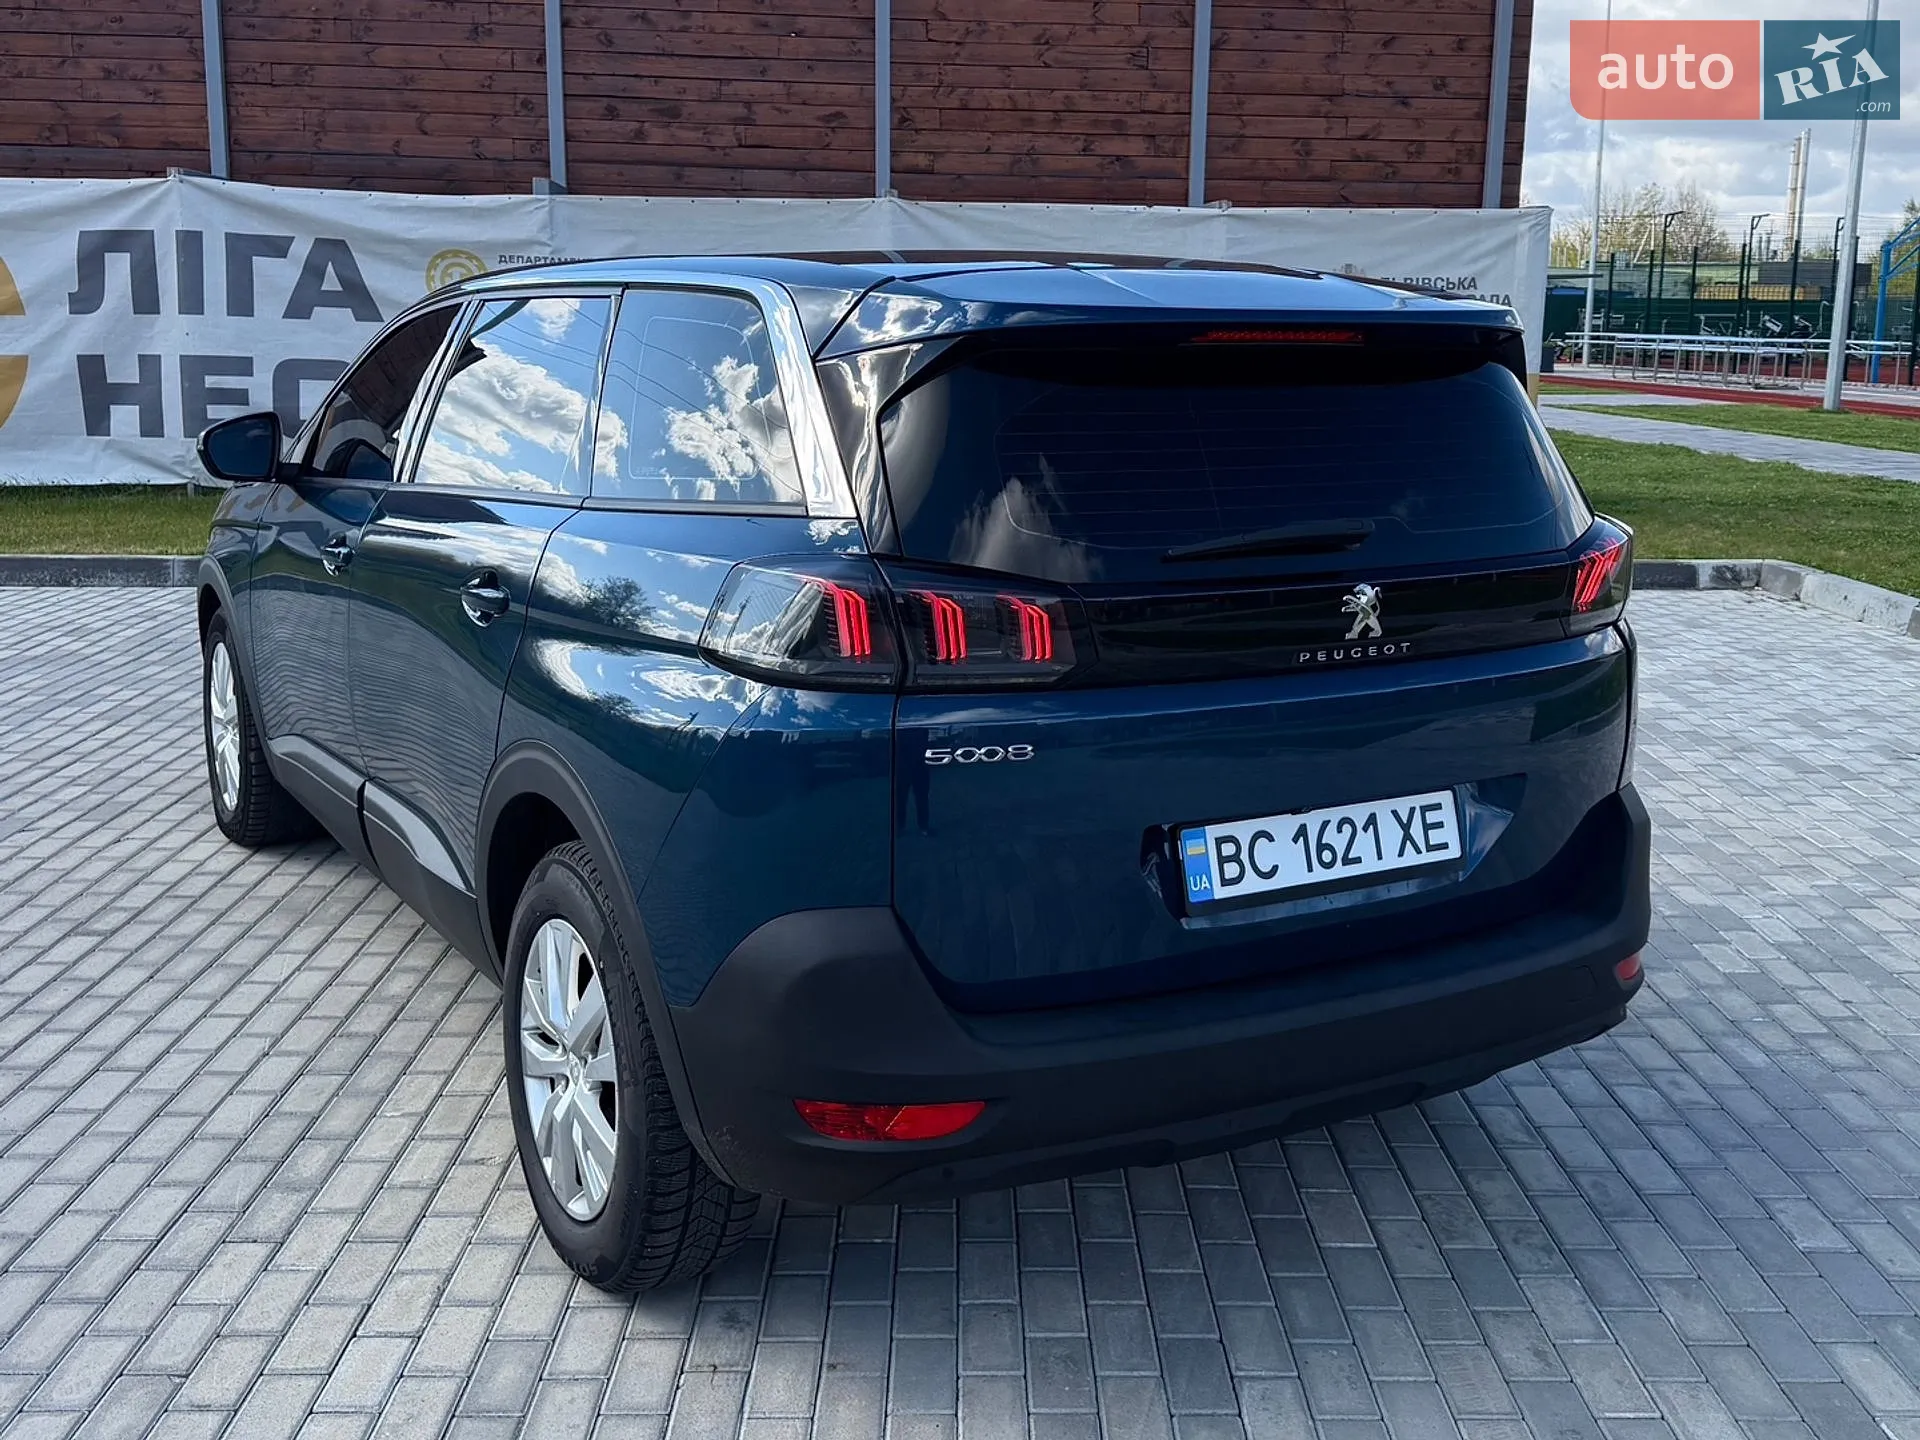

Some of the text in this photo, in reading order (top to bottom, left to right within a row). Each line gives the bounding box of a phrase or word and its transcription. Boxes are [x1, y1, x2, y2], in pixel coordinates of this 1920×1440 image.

[68, 229, 385, 323] ЛІГА
[1299, 642, 1412, 663] PEUGEOT
[923, 743, 1035, 766] 5008
[1214, 802, 1450, 888] BC 1621 XE
[1189, 873, 1211, 892] UA
